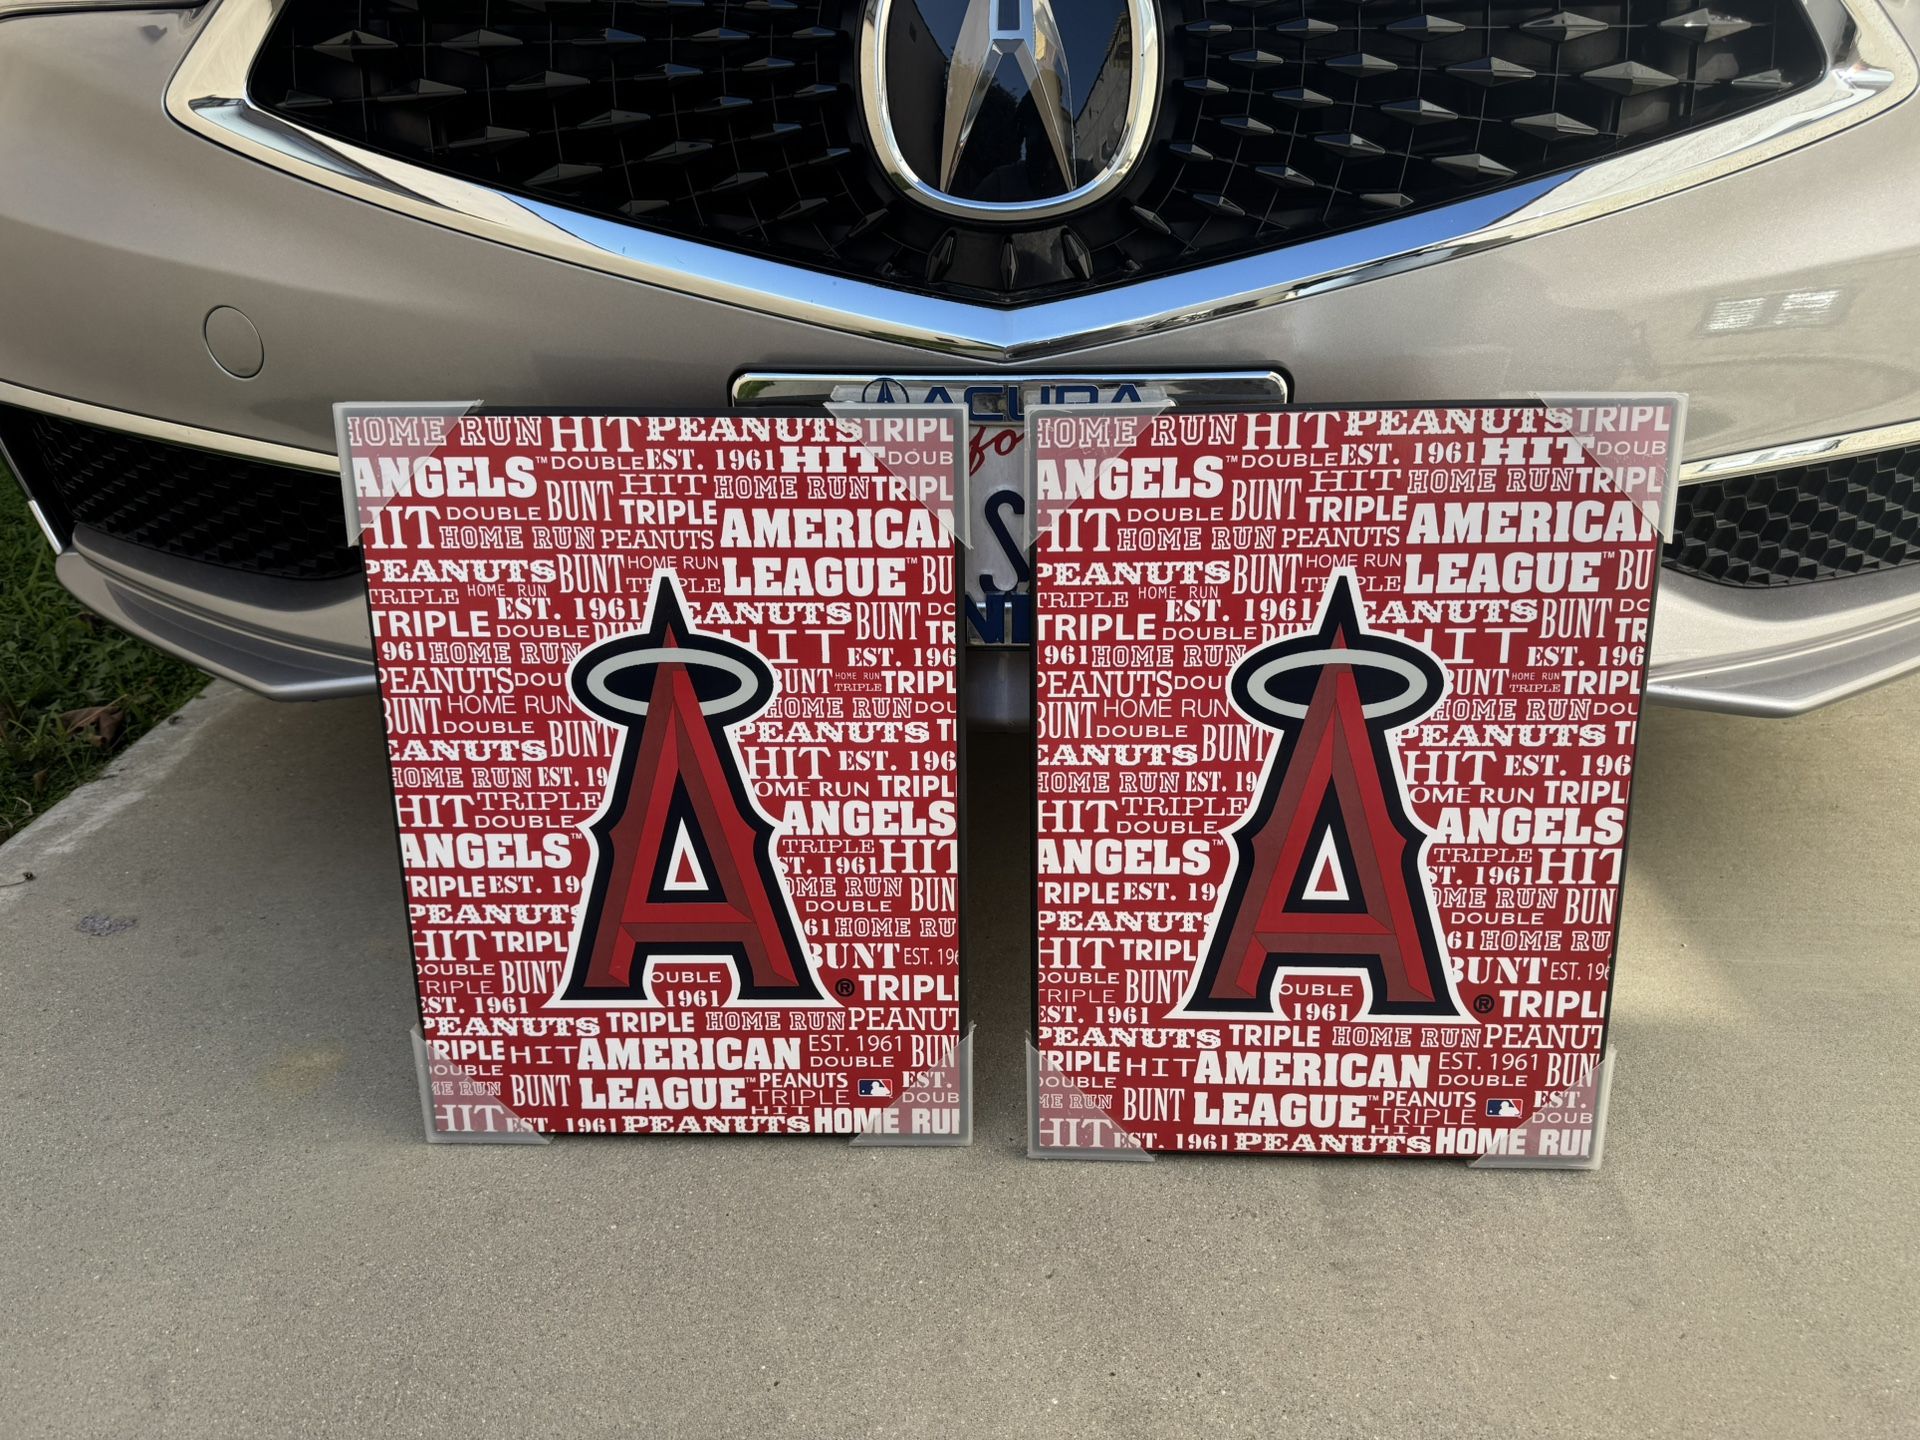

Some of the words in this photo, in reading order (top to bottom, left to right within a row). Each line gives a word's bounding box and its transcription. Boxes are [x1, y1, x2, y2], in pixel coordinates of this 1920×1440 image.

[458, 416, 541, 445] RUN
[647, 415, 863, 442] PEANUTS
[1151, 414, 1236, 446] RUN
[1243, 412, 1342, 450] HIT
[1339, 407, 1572, 439] PEANUTS
[550, 416, 641, 452] HIT
[646, 449, 703, 470] EST.
[716, 450, 774, 470] 1961
[780, 446, 885, 473] HIT
[1242, 453, 1337, 468] DOUBLE
[1341, 444, 1399, 465] EST.
[1414, 442, 1474, 464] 1961
[1481, 436, 1594, 465] HIT
[552, 456, 644, 470] DOUBLE
[620, 474, 707, 495] HIT
[714, 476, 797, 499] HOME
[807, 476, 869, 499] RUN
[1310, 469, 1400, 492] HIT
[1407, 469, 1496, 493] HOME
[1506, 468, 1573, 492] RUN
[546, 481, 613, 521] BUNT
[1231, 479, 1302, 520] BUNT
[1306, 495, 1407, 522] TRIPLE
[447, 507, 541, 520] DOUBLE
[619, 500, 717, 524] TRIPLE
[1128, 507, 1223, 522] DOUBLE
[439, 526, 523, 548] HOME
[532, 526, 594, 549] RUN
[601, 530, 714, 549] PEANUTS
[1117, 527, 1201, 551] HOME
[1212, 526, 1276, 549] RUN
[1282, 526, 1399, 548] PEANUTS
[628, 556, 677, 571] HOME
[683, 556, 718, 569] RUN
[1307, 554, 1357, 569] HOME
[1364, 554, 1401, 567] RUN
[555, 554, 627, 593] BUNT
[1228, 554, 1306, 594] BUNT
[369, 589, 459, 604] TRIPLE
[468, 584, 504, 598] HOME
[518, 582, 546, 598] RUN
[1037, 592, 1128, 608] TRIPLE
[1139, 586, 1176, 599] HOME
[1190, 586, 1218, 598] RUN
[497, 597, 560, 619] EST.
[575, 598, 639, 619] 1961
[1166, 599, 1229, 621] EST.
[1245, 598, 1316, 621] 1961
[1539, 598, 1612, 638] BUNT
[372, 611, 490, 637] TRIPLE
[855, 602, 920, 639] BUNT
[1038, 614, 1155, 640] TRIPLE
[497, 625, 589, 637] DOUBLE
[1163, 627, 1256, 640] DOUBLE
[429, 642, 511, 663] HOME
[520, 643, 583, 665] RUN
[848, 648, 901, 666] EST.
[1092, 645, 1173, 667] HOME
[1184, 645, 1249, 667] RUN
[1527, 647, 1584, 666] EST.
[1510, 684, 1560, 692] TRIPLE
[448, 695, 515, 714] HOME
[525, 694, 574, 714] RUN
[764, 696, 843, 718] HOME
[853, 698, 912, 718] RUN
[1104, 699, 1171, 718] HOME
[1182, 698, 1233, 717] RUN
[1431, 699, 1517, 720] HOME
[1526, 699, 1591, 720] RUN
[444, 721, 534, 733] DOUBLE
[734, 720, 929, 744] PEANUTS
[1097, 725, 1187, 737] DOUBLE
[1396, 724, 1605, 746] PEANUTS
[742, 747, 830, 781] HIT
[839, 751, 896, 770] EST.
[1401, 751, 1496, 785] HIT
[1505, 755, 1566, 776] EST.
[472, 768, 531, 788] RUN
[1119, 772, 1179, 793] RUN
[473, 792, 604, 812] TRIPLE
[1122, 797, 1252, 817] TRIPLE
[475, 816, 576, 828] DOUBLE
[780, 801, 956, 836] ANGELS
[1117, 821, 1220, 834] DOUBLE
[1434, 807, 1623, 844] ANGELS
[783, 839, 874, 853] TRIPLE
[1434, 848, 1532, 863] TRIPLE
[806, 901, 891, 912] DOUBLE
[835, 918, 910, 937] HOME
[1452, 912, 1543, 924] DOUBLE
[1480, 930, 1562, 951] HOME
[904, 948, 932, 965] EST.
[1551, 962, 1580, 980] EST.
[476, 997, 527, 1013] 1961
[667, 990, 718, 1007] 1961
[606, 1012, 694, 1032] TRIPLE
[706, 1012, 780, 1030] HOME
[789, 1012, 845, 1030] RUN
[1096, 1007, 1148, 1024] 1961
[1294, 1003, 1347, 1021] 1961
[809, 1035, 848, 1051] EST.
[857, 1035, 901, 1051] 1961
[1229, 1025, 1320, 1047] TRIPLE
[1332, 1026, 1412, 1047] HOME
[1421, 1028, 1481, 1048] RUN
[511, 1046, 580, 1066] HIT
[578, 1037, 800, 1070] AMERICAN
[811, 1057, 894, 1067] DOUBLE
[1439, 1052, 1481, 1069] EST.
[1491, 1053, 1537, 1070] 1961
[1127, 1058, 1196, 1077] HIT
[1191, 1051, 1430, 1088] AMERICAN
[760, 1073, 848, 1088] PEANUTS
[903, 1072, 951, 1088] EST.
[1439, 1075, 1527, 1086] DOUBLE
[511, 1075, 570, 1106] BUNT
[753, 1090, 848, 1104] TRIPLE
[1383, 1091, 1476, 1109] PEANUTS
[1534, 1091, 1586, 1108] EST.
[1123, 1088, 1184, 1121] BUNT
[622, 1116, 810, 1133] PEANUTS
[814, 1108, 899, 1133] HOME
[1372, 1108, 1476, 1127] TRIPLE
[1235, 1131, 1430, 1153] PEANUTS
[1436, 1128, 1527, 1155] HOME
